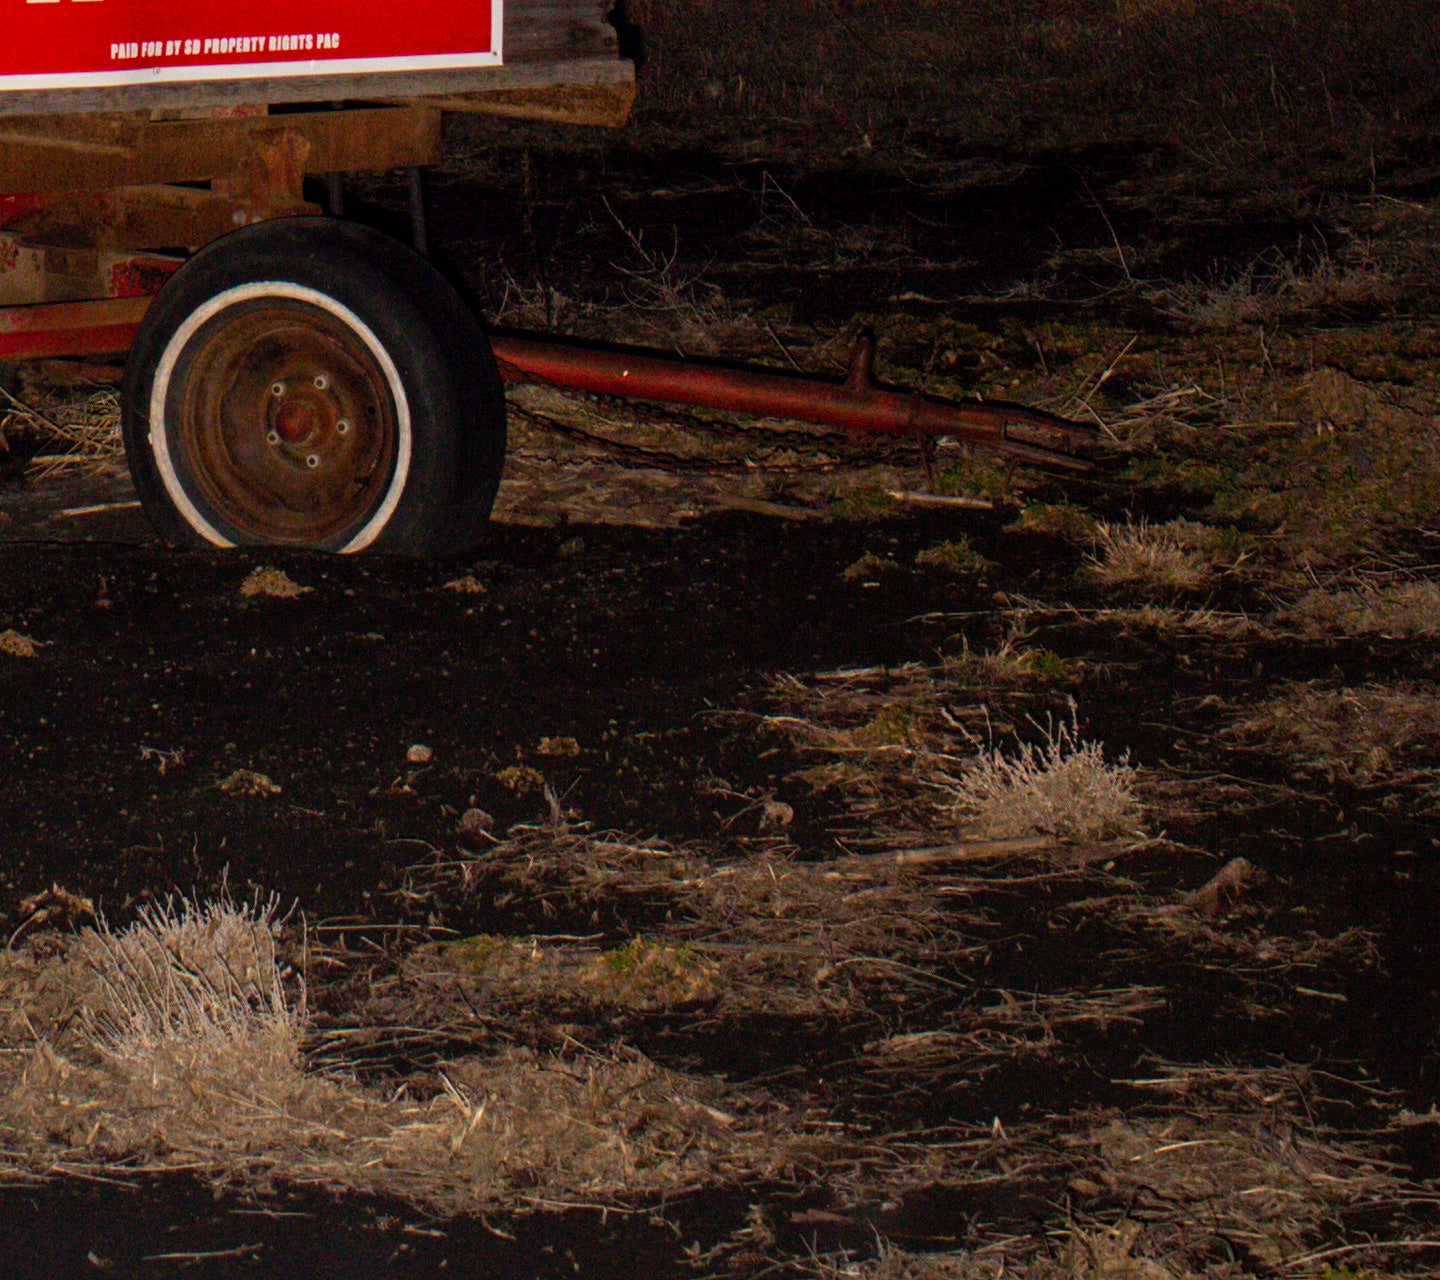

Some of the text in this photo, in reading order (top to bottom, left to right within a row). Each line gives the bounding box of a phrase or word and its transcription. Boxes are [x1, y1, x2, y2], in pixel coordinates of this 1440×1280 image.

[110, 32, 340, 59] PAID FOR BY SD PROPERTY RIGHTS PAC
